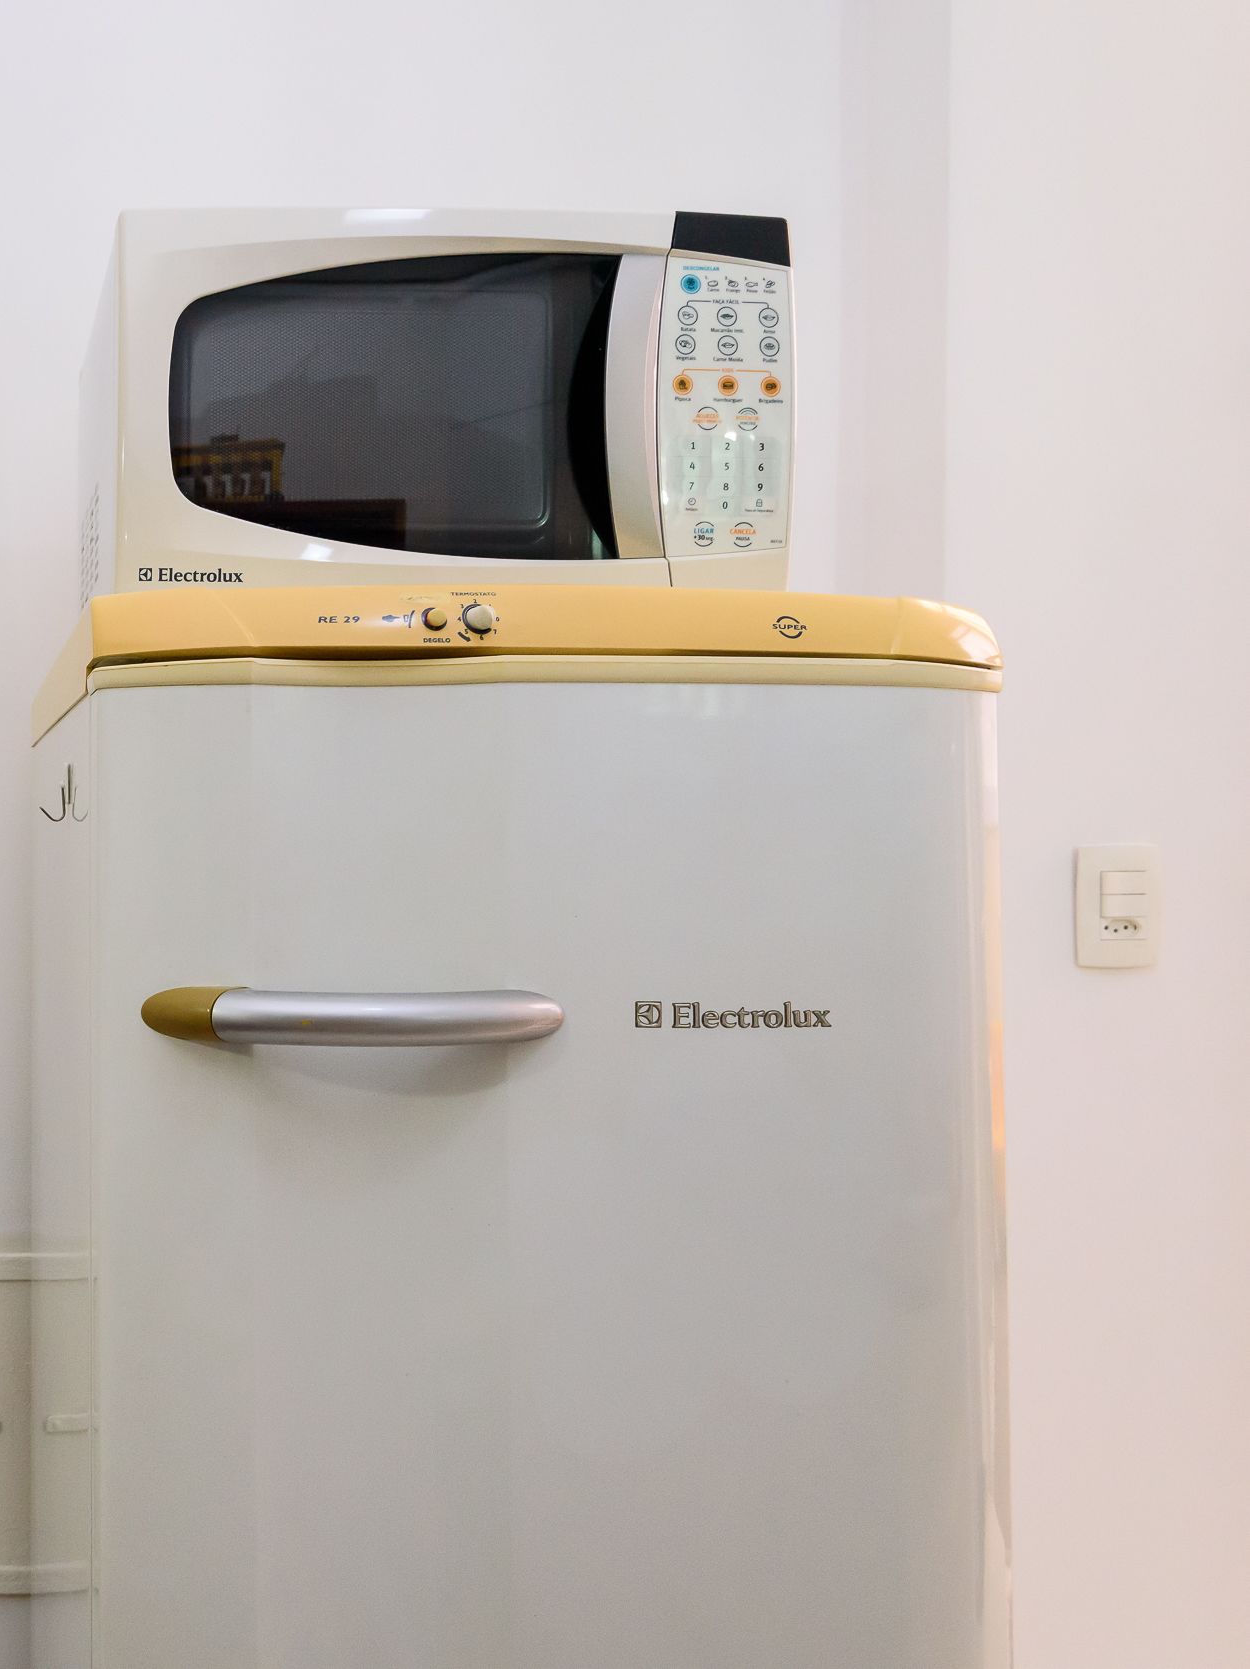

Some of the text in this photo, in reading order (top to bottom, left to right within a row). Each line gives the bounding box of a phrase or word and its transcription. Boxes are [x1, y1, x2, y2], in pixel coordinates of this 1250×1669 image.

[691, 442, 696, 450] 1
[725, 443, 730, 451] 2
[759, 443, 765, 451] 3
[689, 462, 695, 470] 4
[724, 463, 730, 471] 5
[758, 463, 764, 472] 6
[689, 482, 695, 490] 7
[723, 483, 729, 491] 8
[757, 483, 763, 491] 9
[722, 501, 728, 509] 0
[158, 568, 244, 583] Electrolux
[672, 1001, 832, 1029] Electrolux
